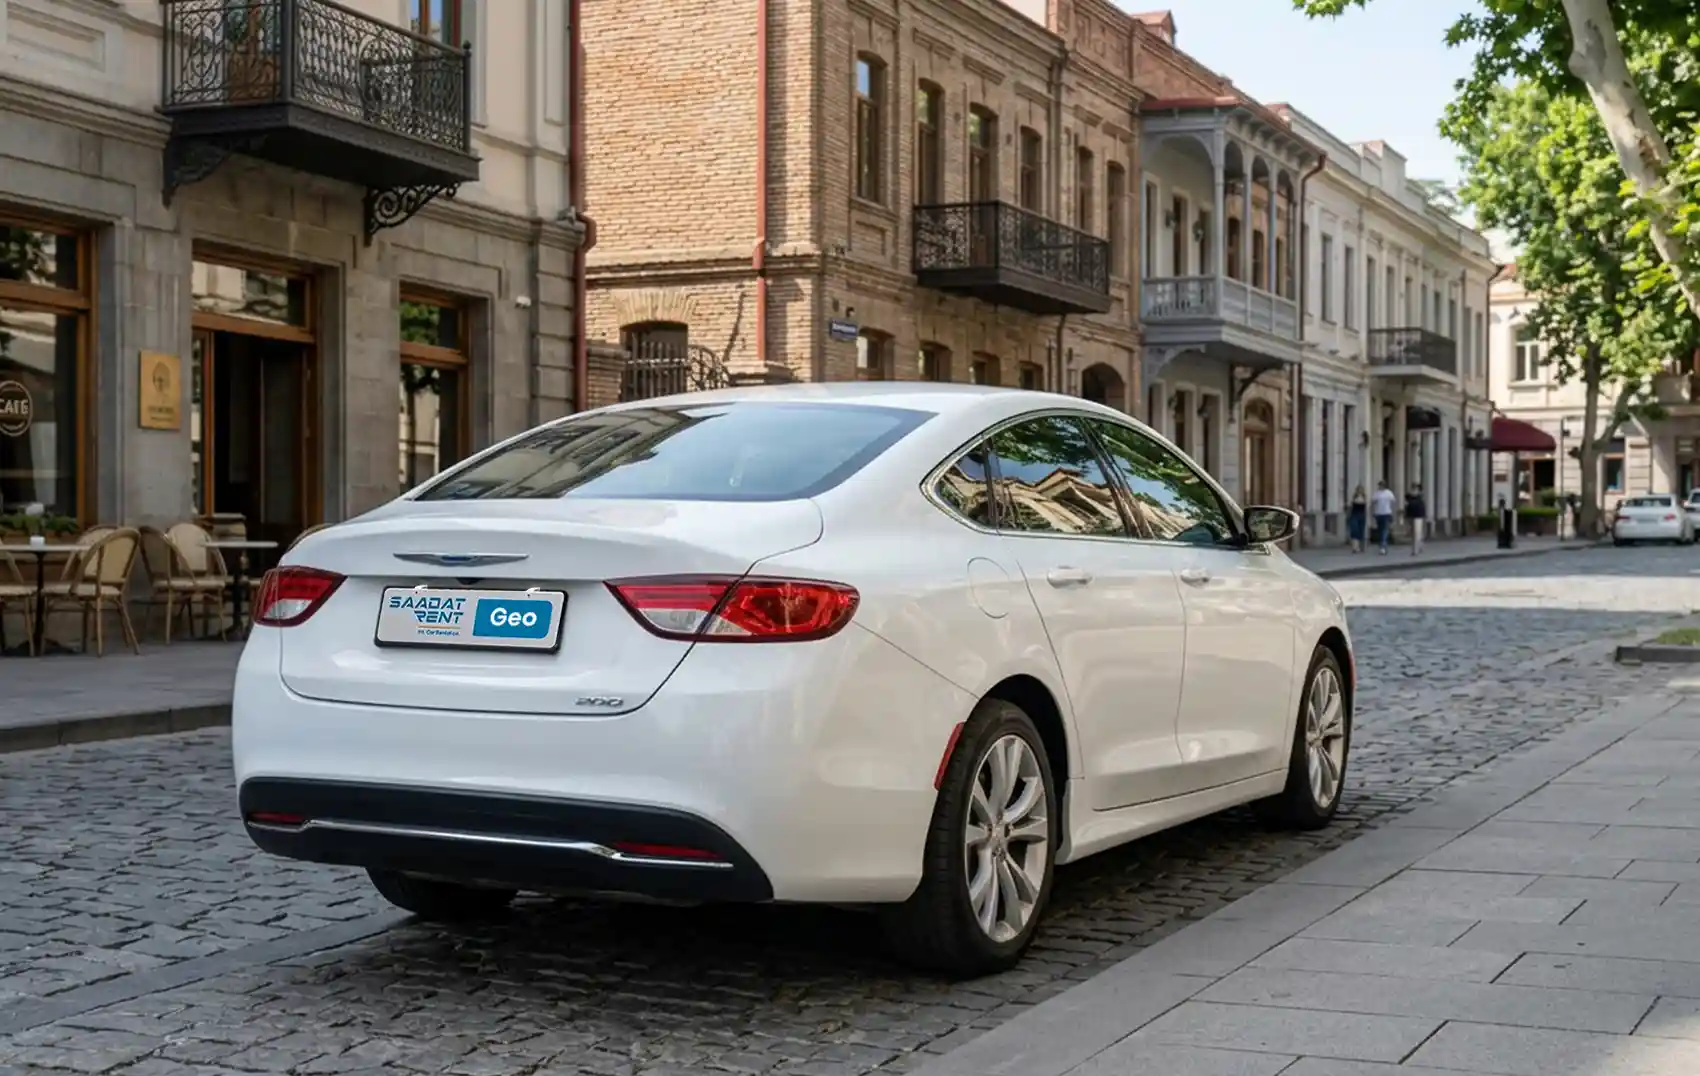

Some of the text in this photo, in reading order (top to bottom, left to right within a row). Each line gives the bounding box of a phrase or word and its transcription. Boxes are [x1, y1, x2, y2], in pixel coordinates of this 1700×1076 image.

[389, 596, 466, 610] SAADAT
[413, 610, 464, 624] RENT
[490, 607, 537, 627] Geo
